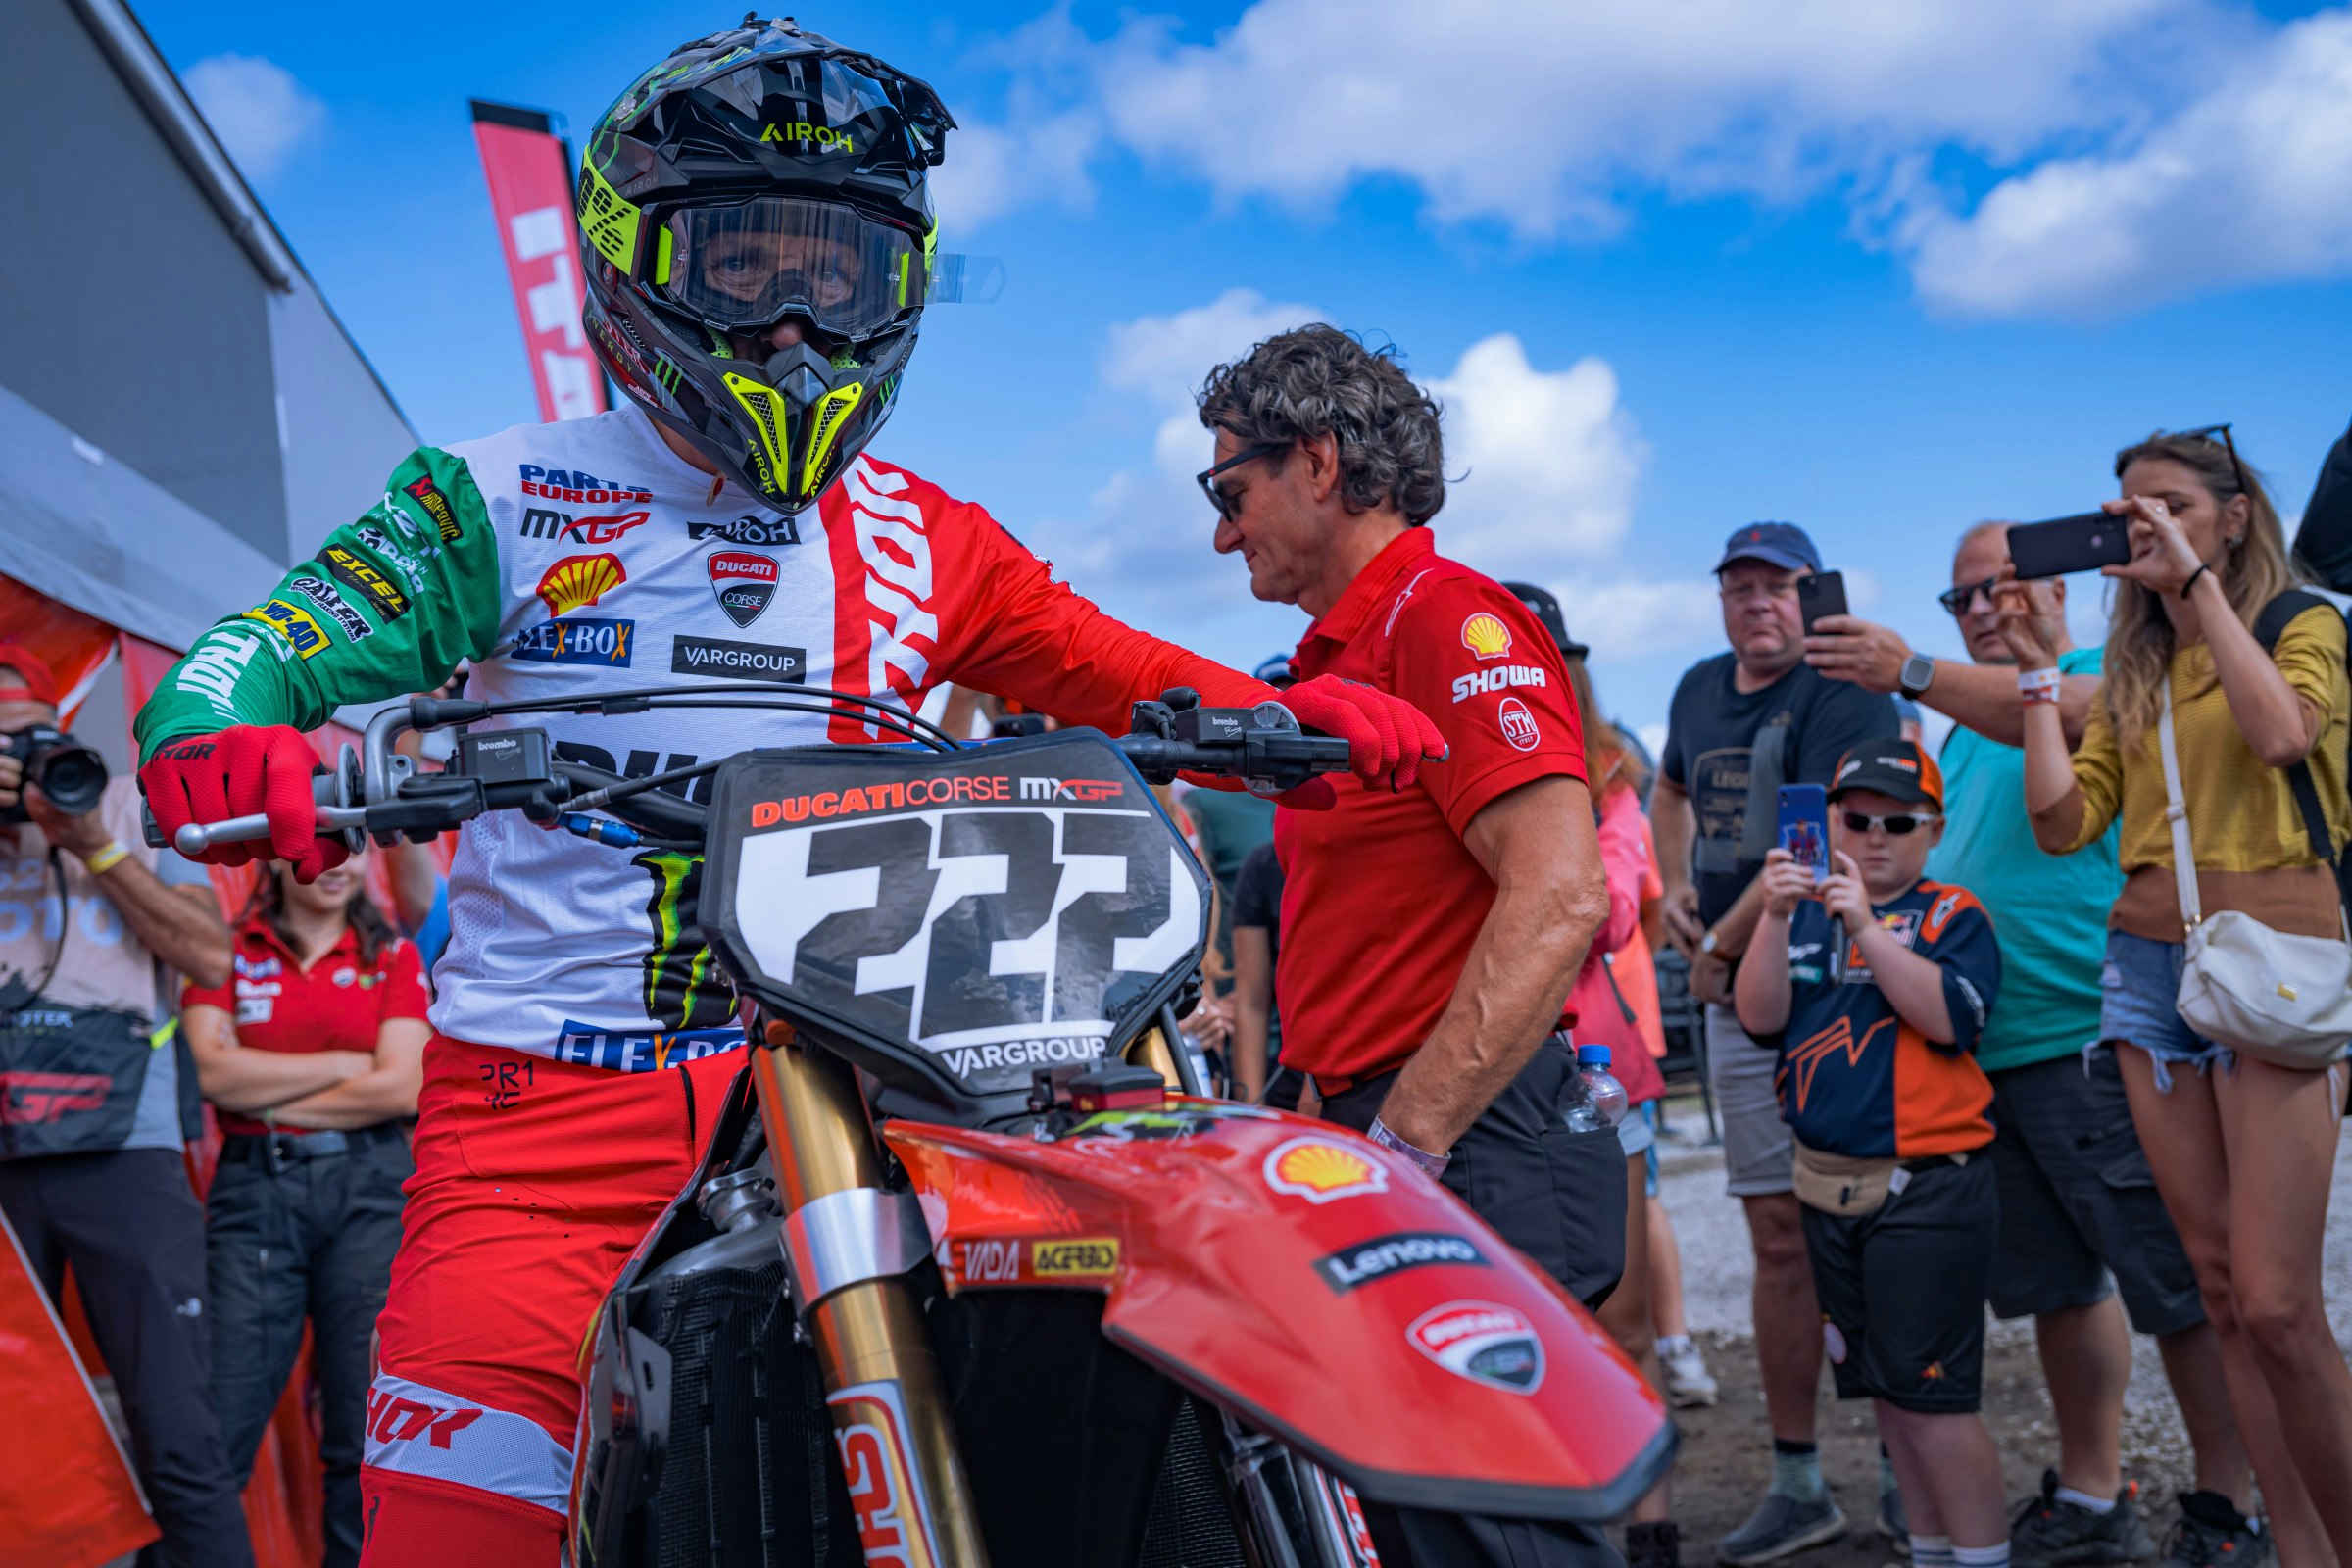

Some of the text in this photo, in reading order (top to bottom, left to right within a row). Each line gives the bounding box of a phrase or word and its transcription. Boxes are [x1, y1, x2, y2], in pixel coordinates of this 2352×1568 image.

[760, 122, 854, 154] AIROH
[625, 174, 660, 197] AIROH
[748, 438, 776, 495] AIROH
[521, 480, 654, 504] EUROPE
[519, 507, 651, 545] MXGP
[327, 548, 404, 612] EXCEL
[715, 560, 772, 577] DUCATI
[292, 577, 372, 640] GALFER
[724, 592, 763, 607] CORSE
[684, 646, 796, 672] VARGROUP
[1452, 665, 1546, 704] SHOWA
[1212, 716, 1239, 727] brembo
[1503, 712, 1537, 738] STM
[478, 739, 517, 751] brembo
[1019, 776, 1124, 802] MXGP
[790, 811, 1172, 1041] 222
[942, 1036, 1106, 1079] VARGROUP
[1328, 1239, 1476, 1285] Lenovo
